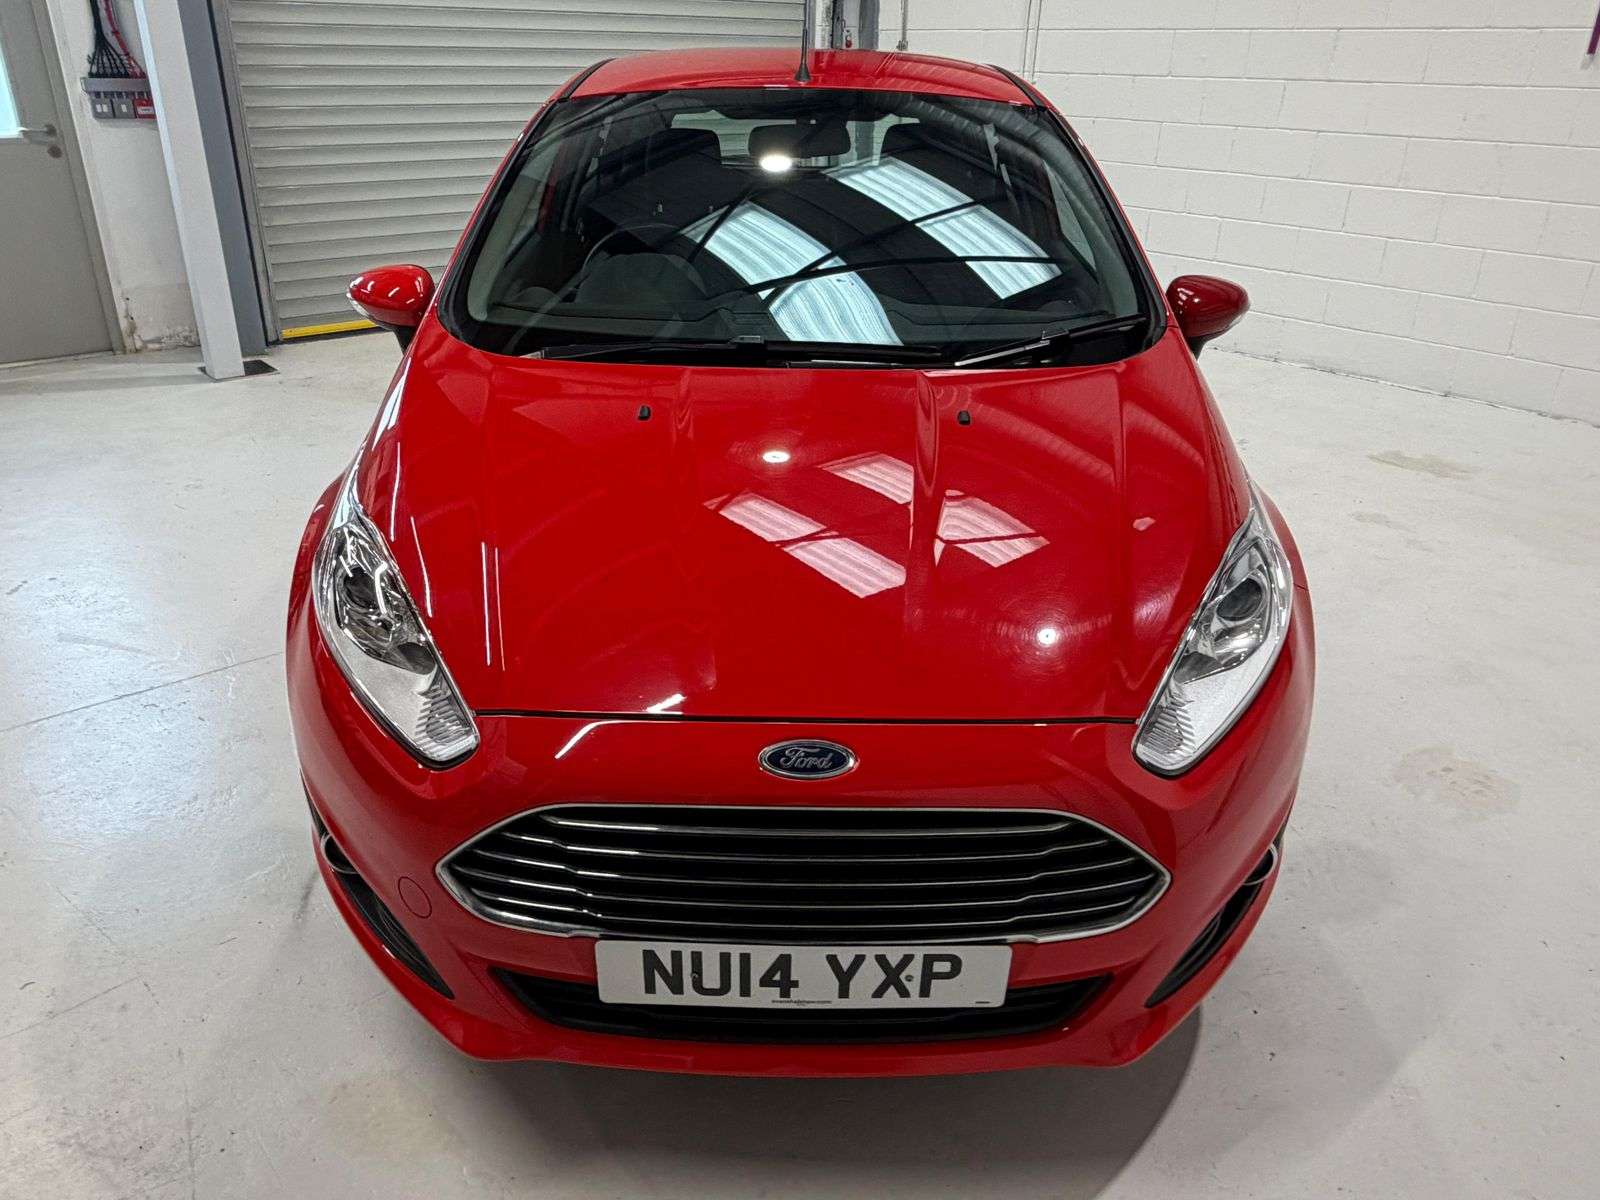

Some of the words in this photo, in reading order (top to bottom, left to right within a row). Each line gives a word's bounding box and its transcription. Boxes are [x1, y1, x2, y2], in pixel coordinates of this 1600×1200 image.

[780, 747, 833, 769] Ford
[642, 949, 799, 999] NU14
[825, 953, 963, 999] YXP
